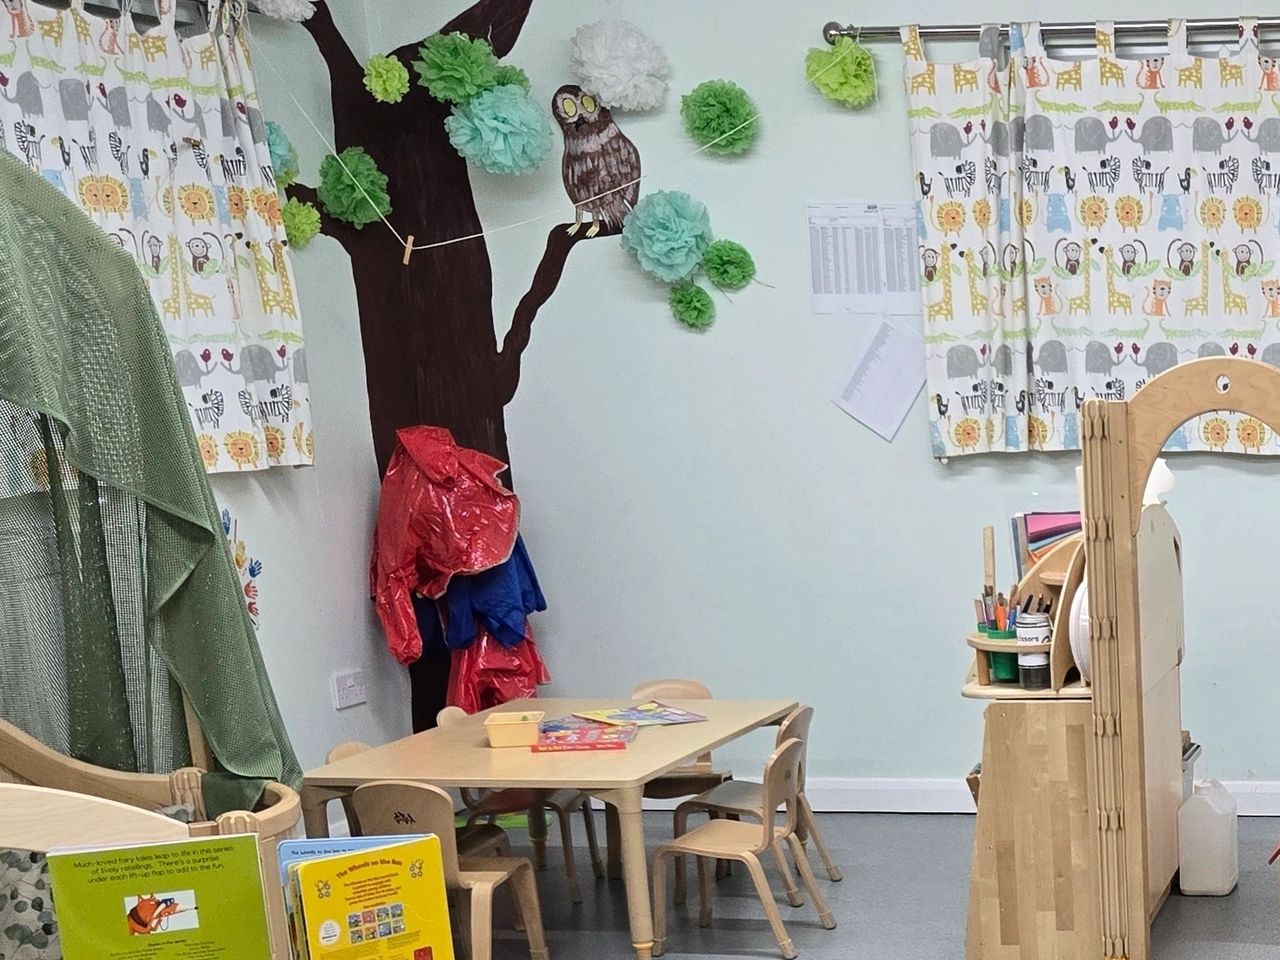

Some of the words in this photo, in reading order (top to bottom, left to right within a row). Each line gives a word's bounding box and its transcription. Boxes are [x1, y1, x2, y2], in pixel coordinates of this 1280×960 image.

[118, 856, 134, 865] fairy
[136, 854, 153, 862] tales
[336, 871, 347, 879] The
[348, 862, 369, 872] Wheels
